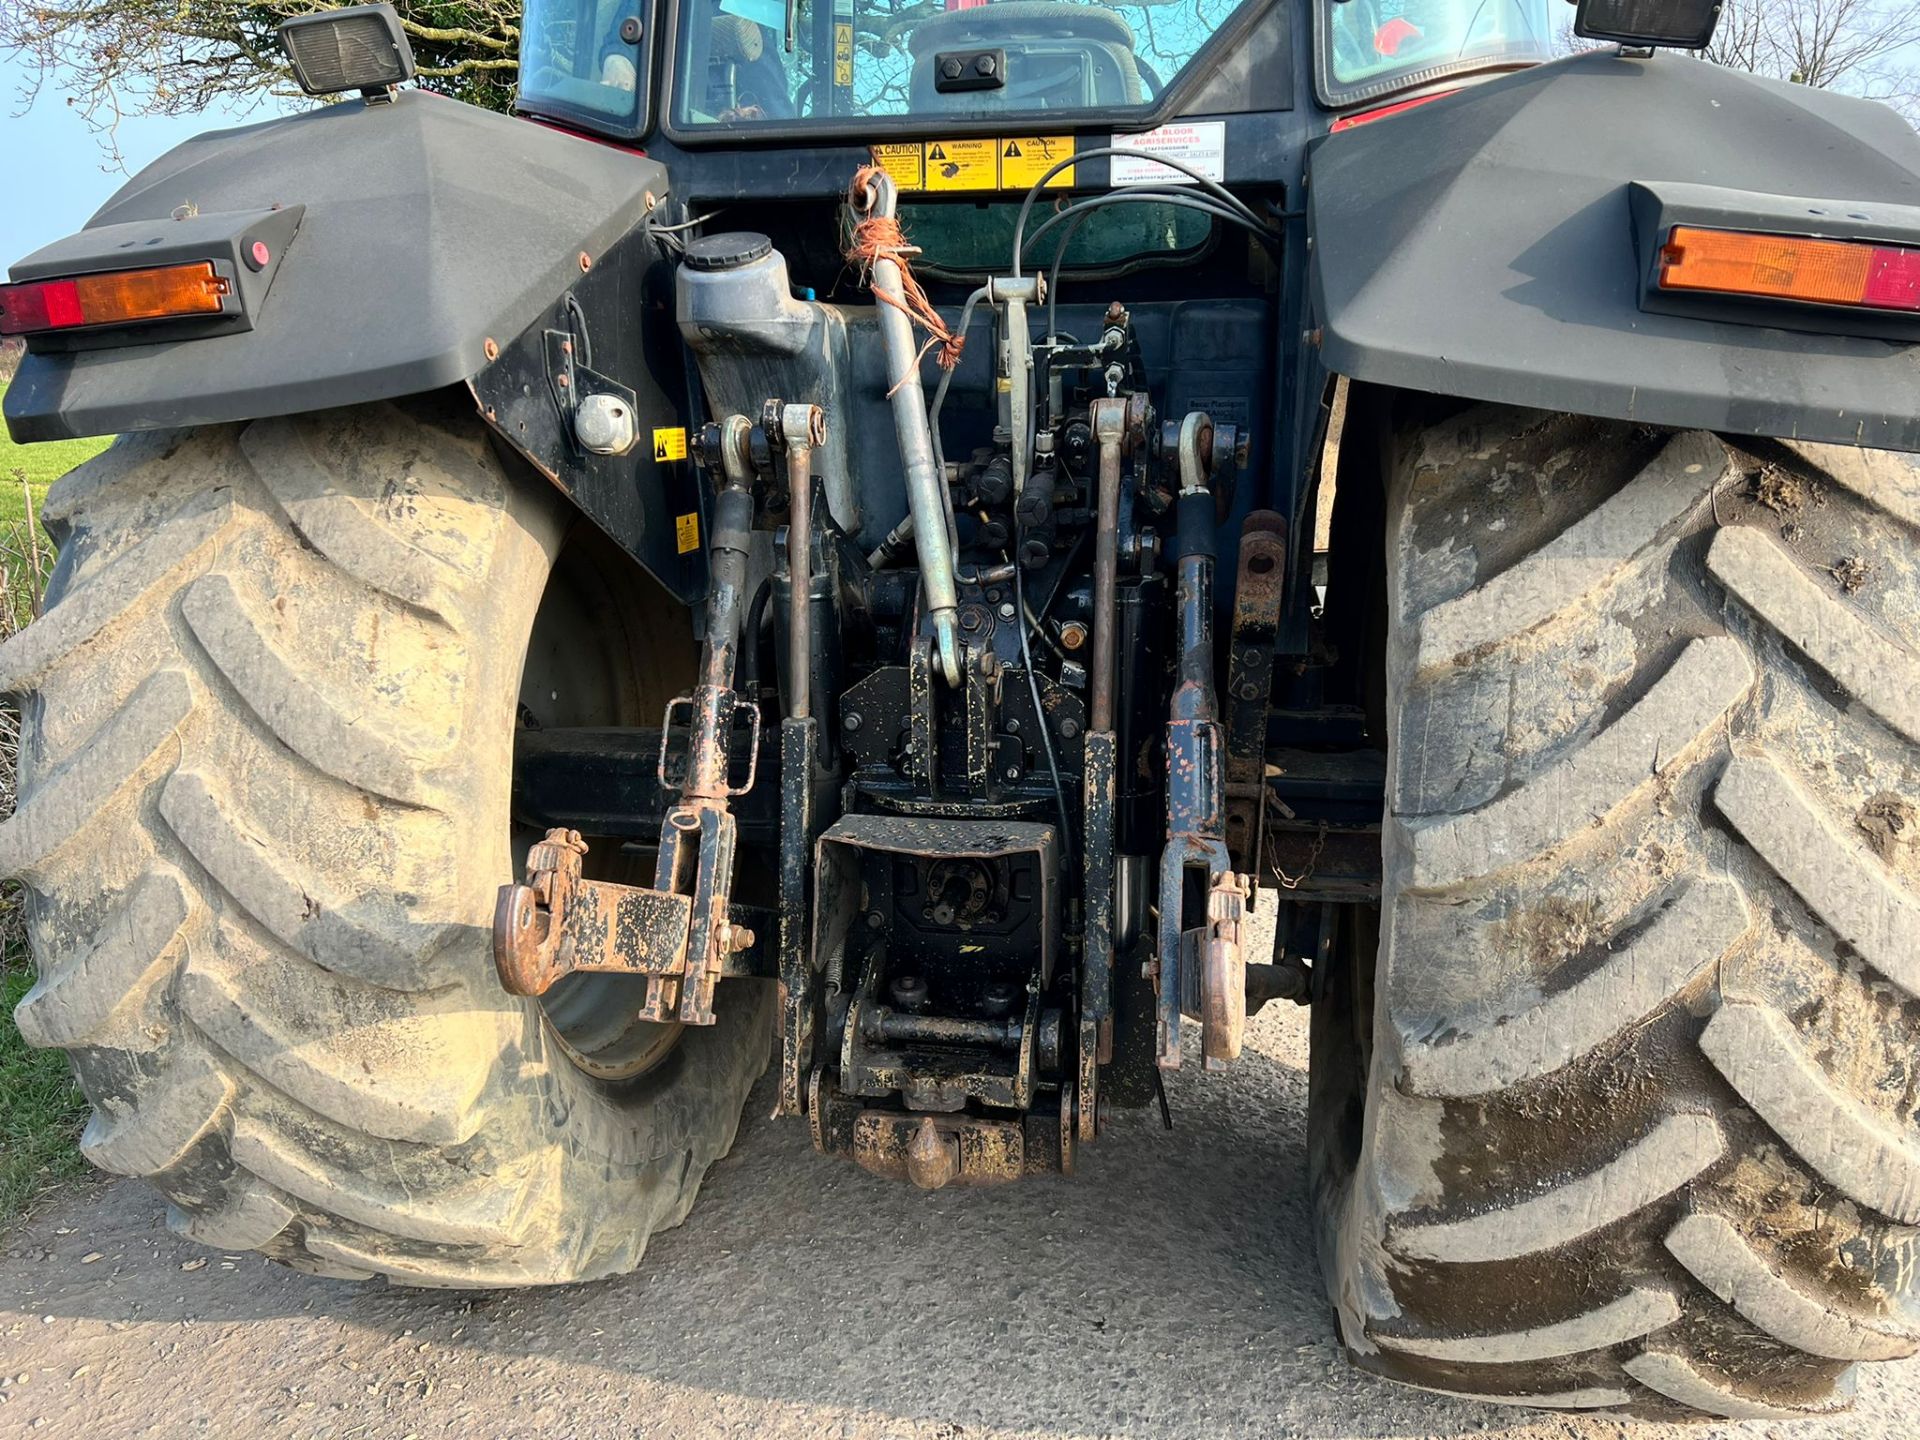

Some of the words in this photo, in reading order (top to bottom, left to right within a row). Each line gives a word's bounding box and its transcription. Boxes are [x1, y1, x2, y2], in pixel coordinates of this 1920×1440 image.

[1026, 139, 1056, 147] CAUTON
[1133, 136, 1200, 145] AGRISERVICES
[885, 144, 920, 154] CAUTION
